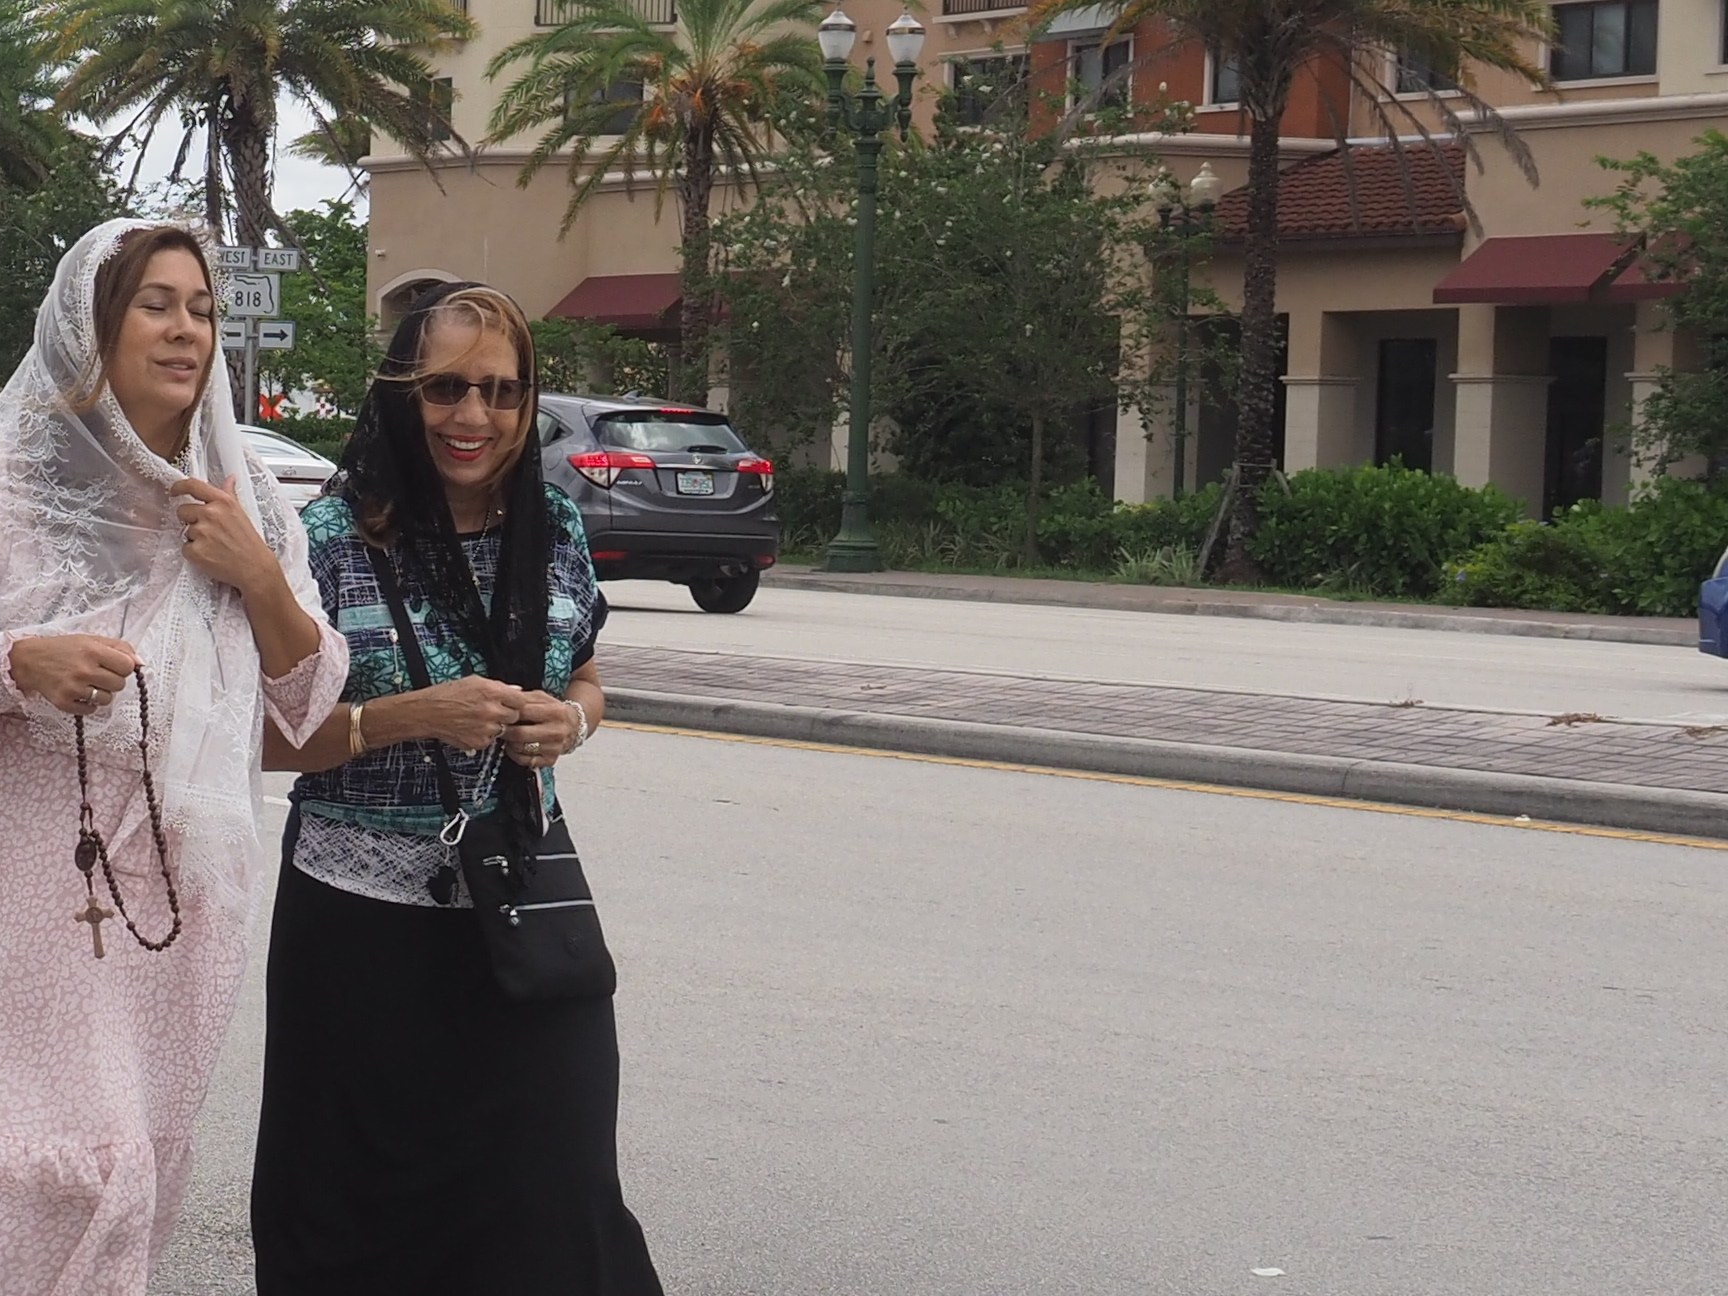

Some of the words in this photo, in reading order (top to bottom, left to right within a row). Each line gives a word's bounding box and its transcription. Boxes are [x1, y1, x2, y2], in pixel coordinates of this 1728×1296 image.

[220, 250, 246, 264] EST
[264, 252, 294, 266] EAST
[235, 290, 262, 308] 818
